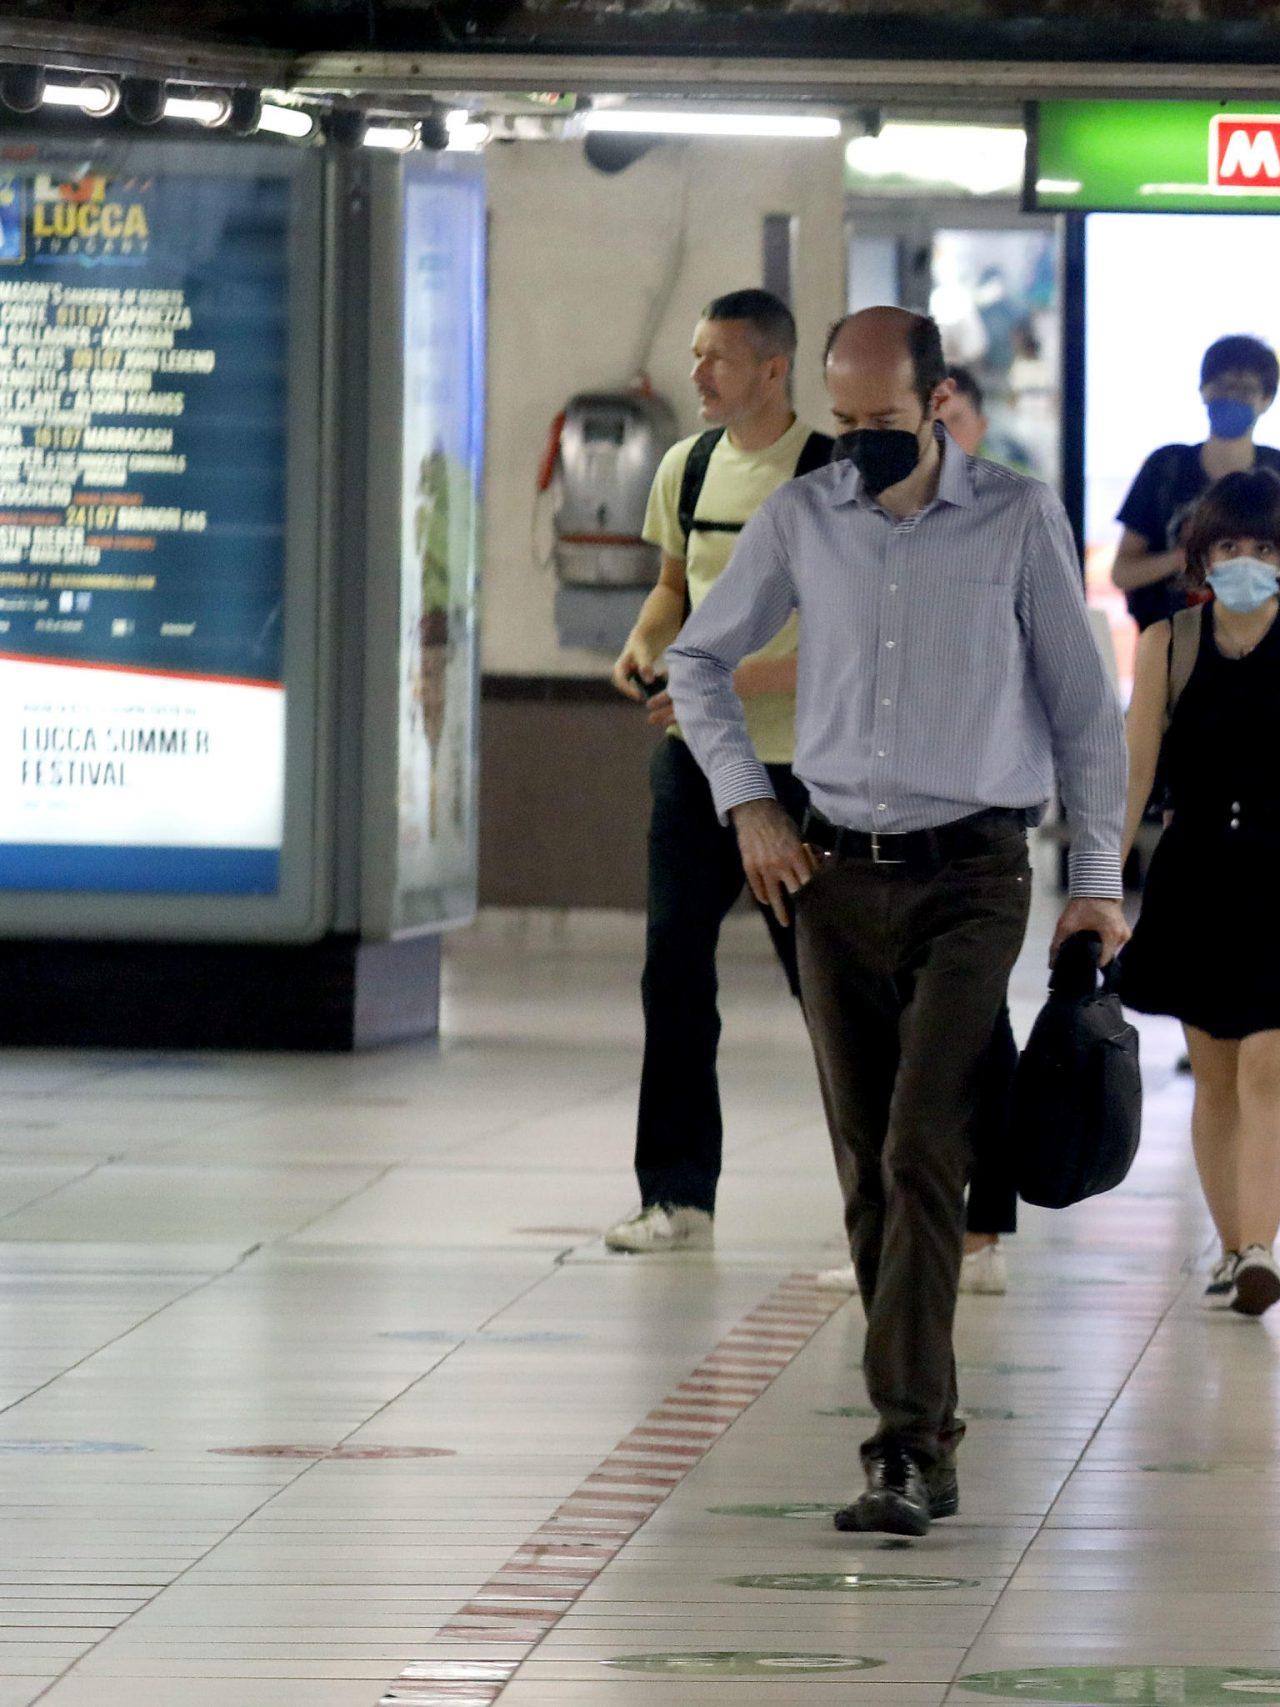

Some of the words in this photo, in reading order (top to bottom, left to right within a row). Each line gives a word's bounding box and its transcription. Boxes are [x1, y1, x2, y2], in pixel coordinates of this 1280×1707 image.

[33, 202, 148, 238] LUCCA
[21, 726, 97, 753] LUCCA
[106, 727, 209, 755] SUMMER
[21, 759, 127, 787] FESTIVAL
